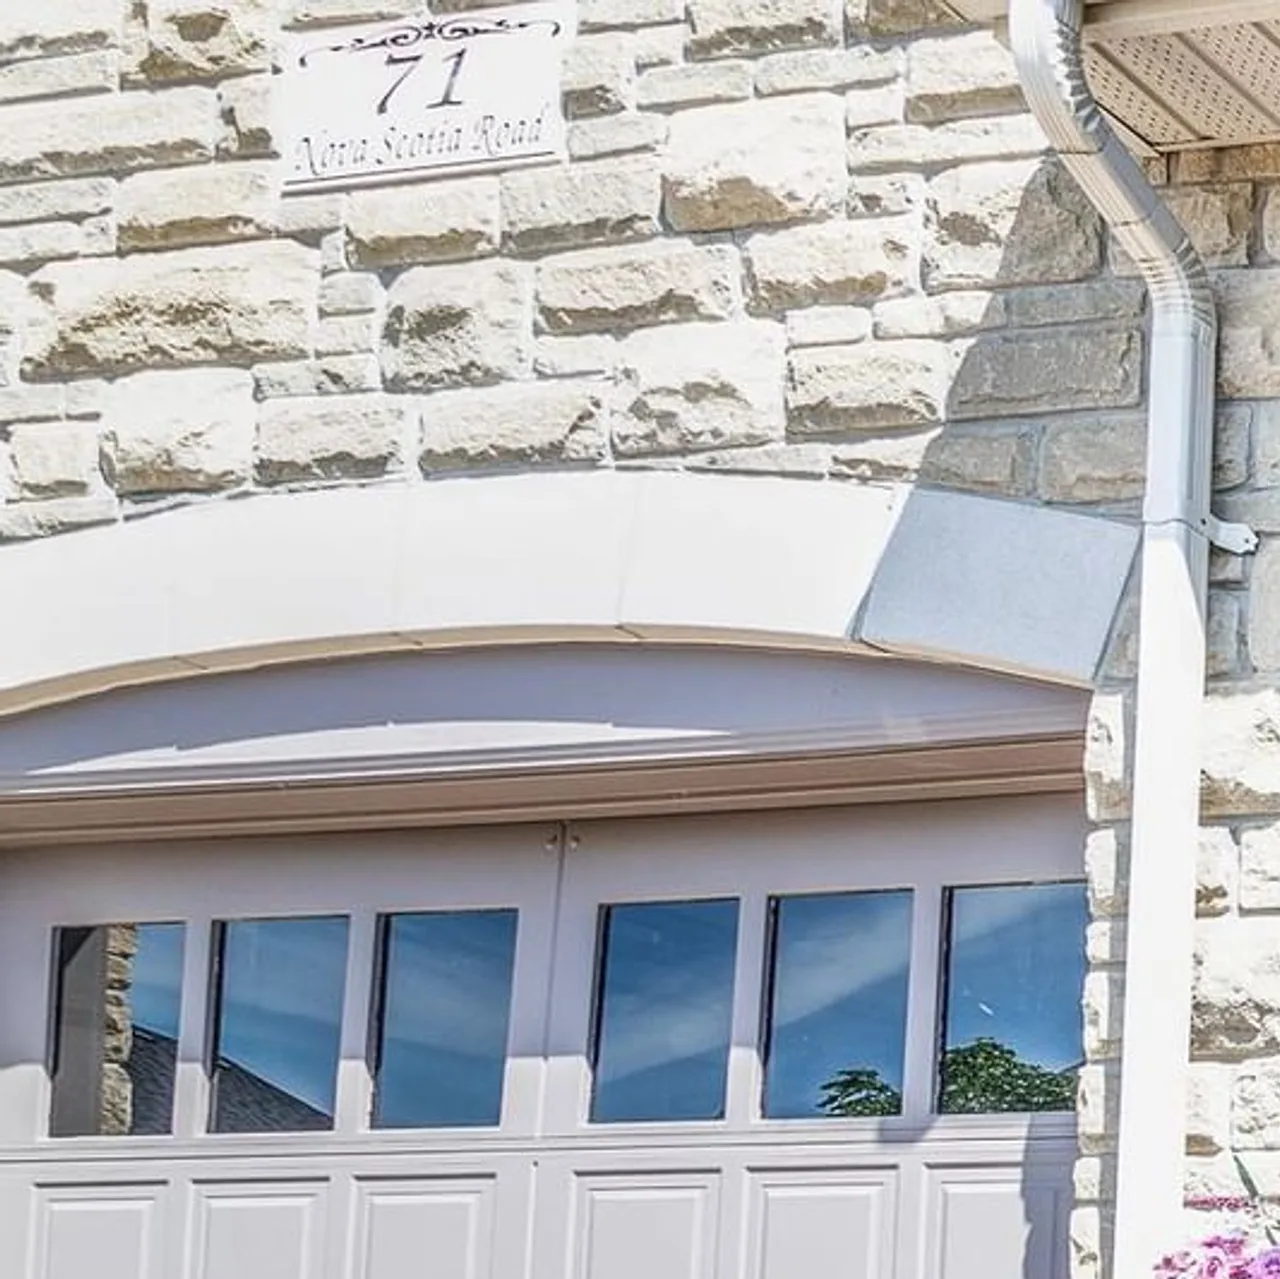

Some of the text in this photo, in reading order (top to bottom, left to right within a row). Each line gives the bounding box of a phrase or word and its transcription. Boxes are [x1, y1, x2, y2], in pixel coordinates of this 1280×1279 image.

[376, 48, 467, 115] 71
[294, 102, 551, 176] Nova Scotia Road
